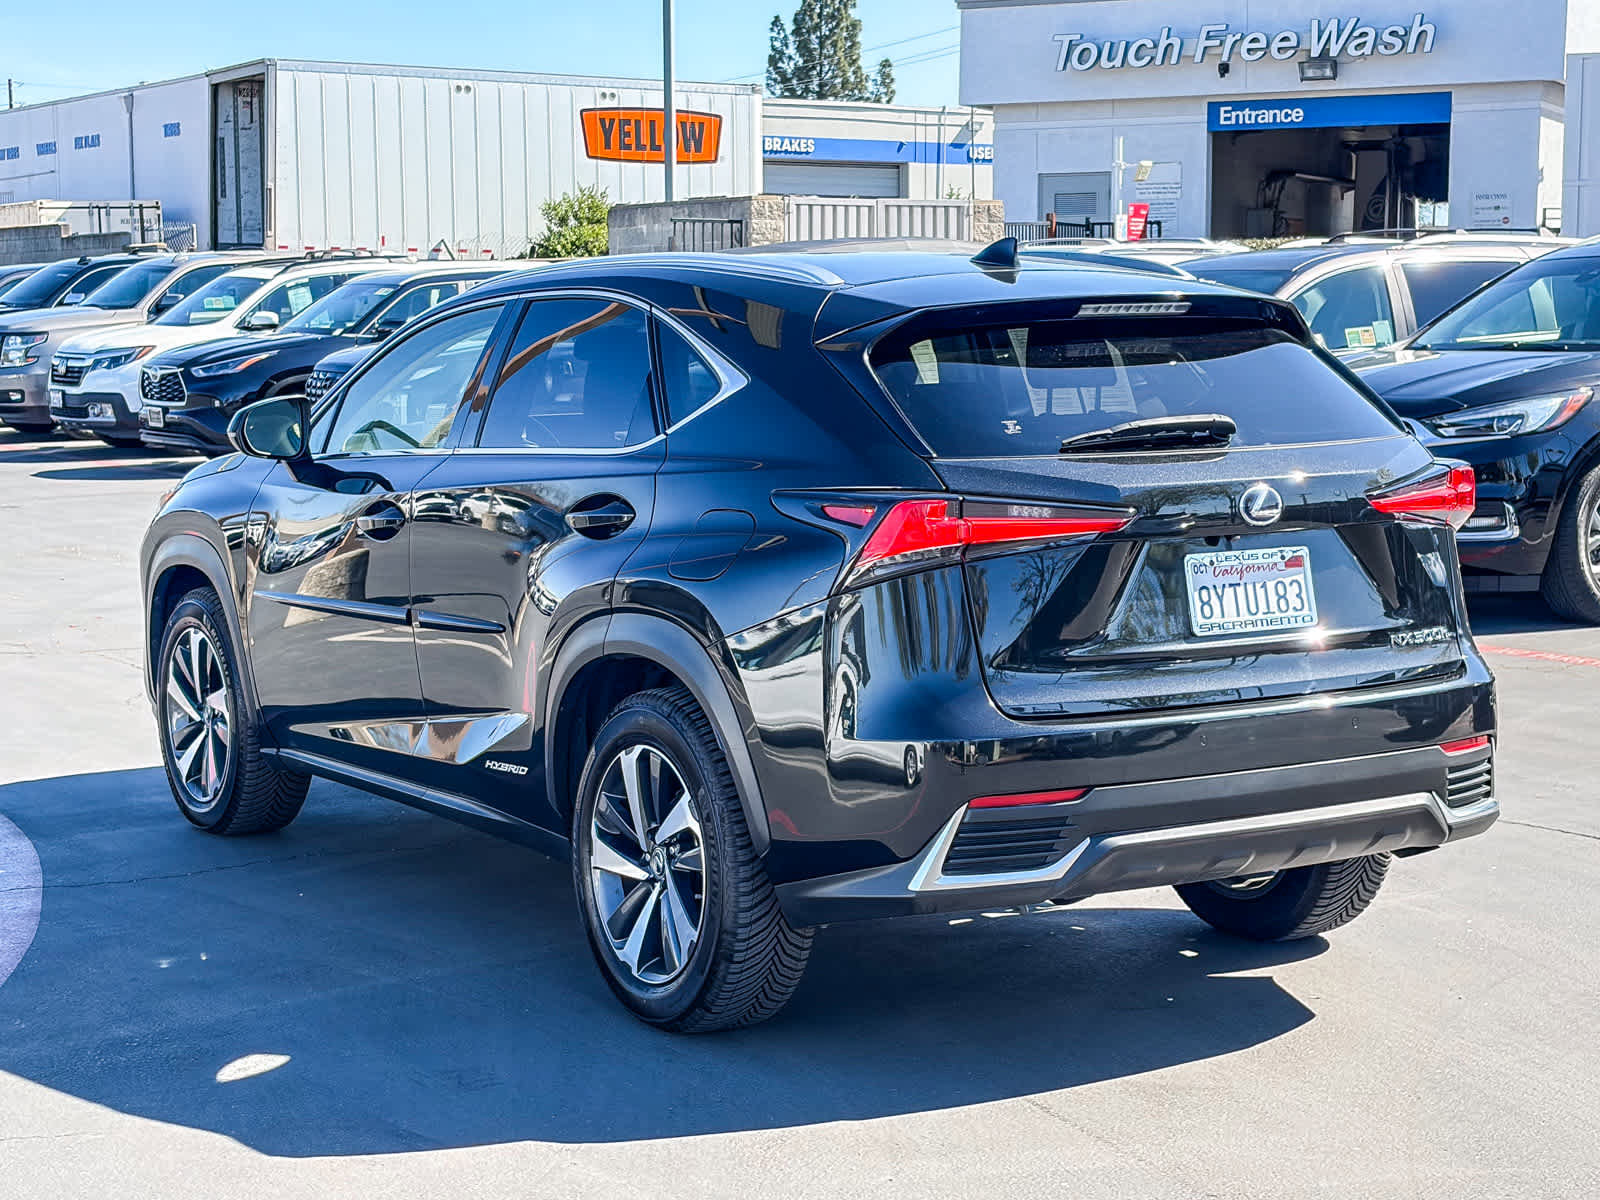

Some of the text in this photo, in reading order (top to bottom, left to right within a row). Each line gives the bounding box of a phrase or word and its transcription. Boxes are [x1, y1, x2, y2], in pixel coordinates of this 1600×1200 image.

[1053, 13, 1437, 73] Touch Free Wash
[1218, 106, 1304, 126] Entrance
[764, 137, 815, 152] BRAKES
[969, 146, 994, 160] USE
[1215, 551, 1279, 563] LEXUS OF
[1193, 564, 1209, 575] OCT
[1212, 562, 1285, 581] California
[1198, 579, 1305, 620] 8YTU183
[1199, 615, 1313, 633] SACRAMENTO
[484, 760, 529, 775] HYBRID
